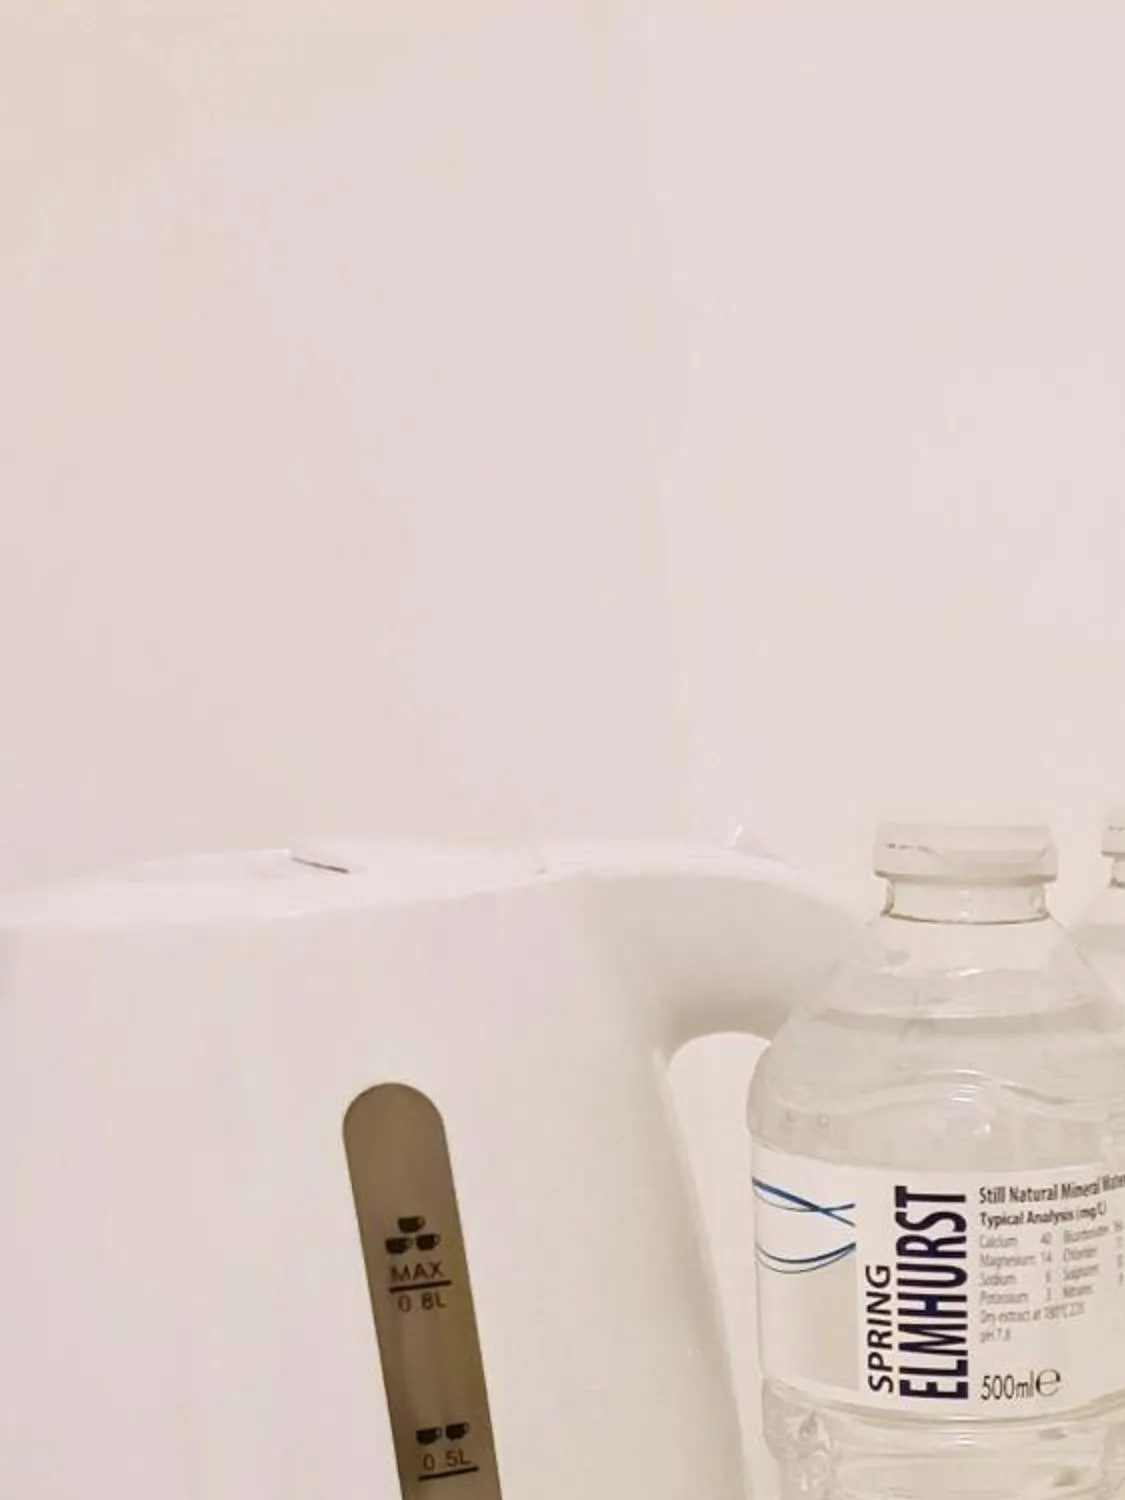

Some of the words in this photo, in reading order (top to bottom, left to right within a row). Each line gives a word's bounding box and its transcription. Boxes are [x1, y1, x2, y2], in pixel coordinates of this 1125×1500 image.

[979, 1186, 1006, 1204] Still
[1009, 1183, 1058, 1203] Natural
[1061, 1179, 1099, 1199] Mineral
[980, 1211, 1024, 1229] Typical
[1027, 1209, 1074, 1226] Analysis
[391, 1260, 445, 1282] MAX
[895, 1186, 968, 1399] ELMHURST
[866, 1265, 893, 1393] SPRING
